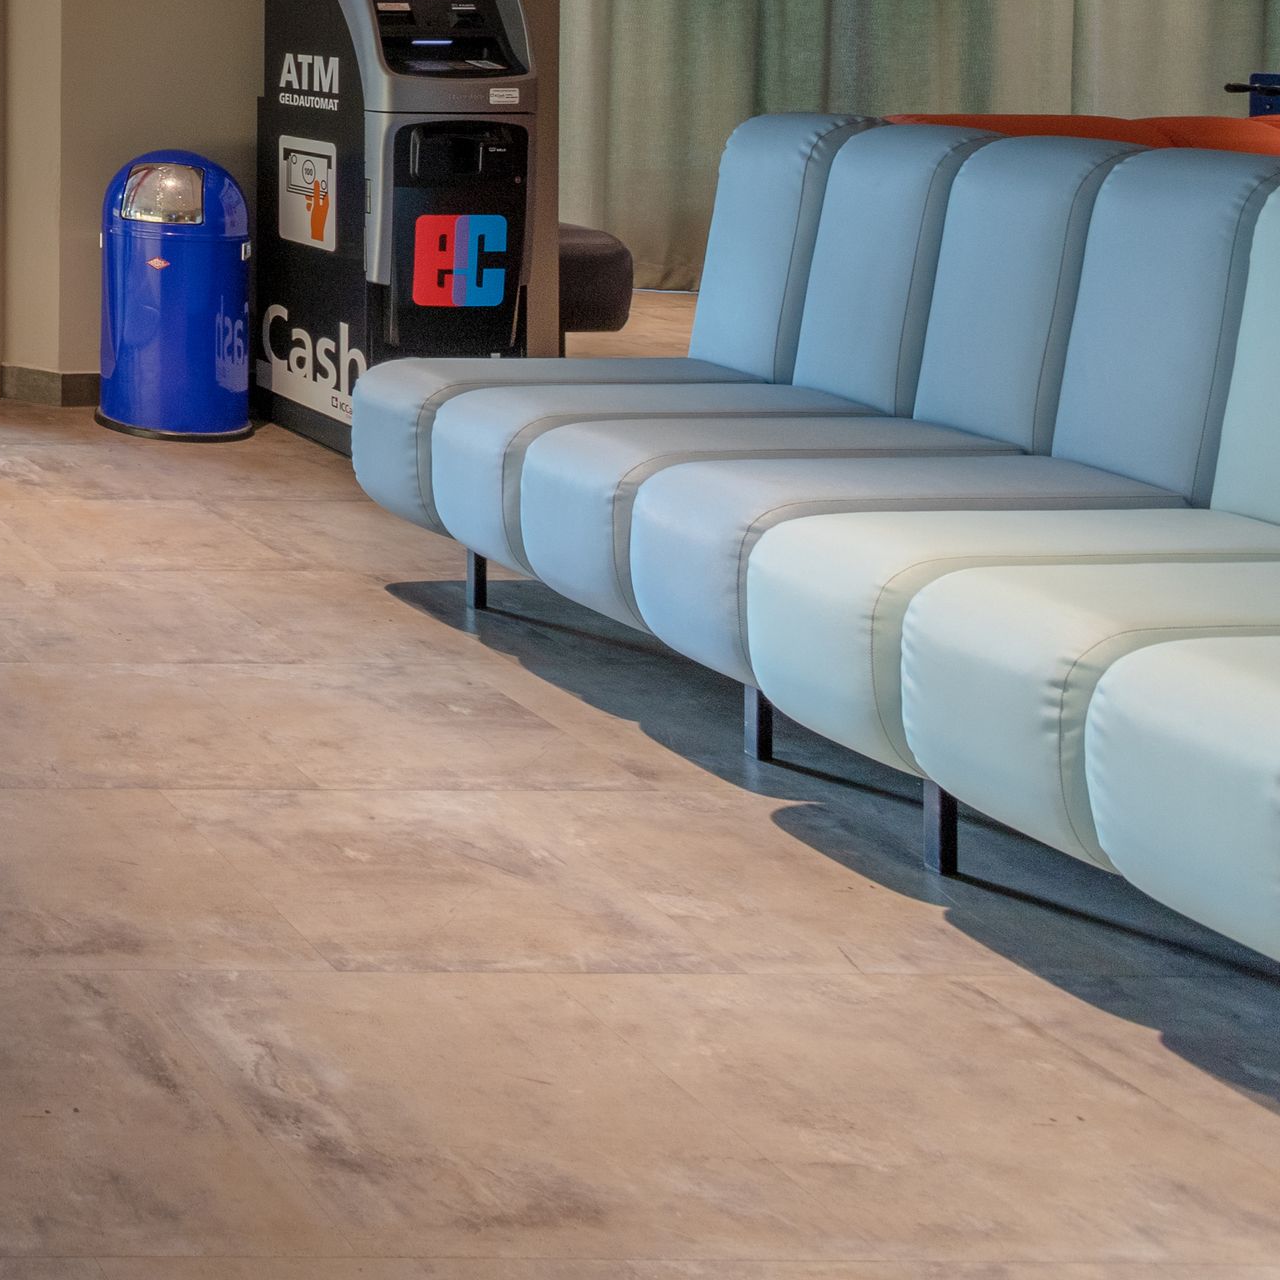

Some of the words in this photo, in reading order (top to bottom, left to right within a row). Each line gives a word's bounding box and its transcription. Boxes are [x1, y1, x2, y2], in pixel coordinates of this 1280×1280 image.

[279, 53, 339, 94] ATM
[279, 92, 339, 111] GELDAUTOMAT
[262, 304, 367, 396] Cash
